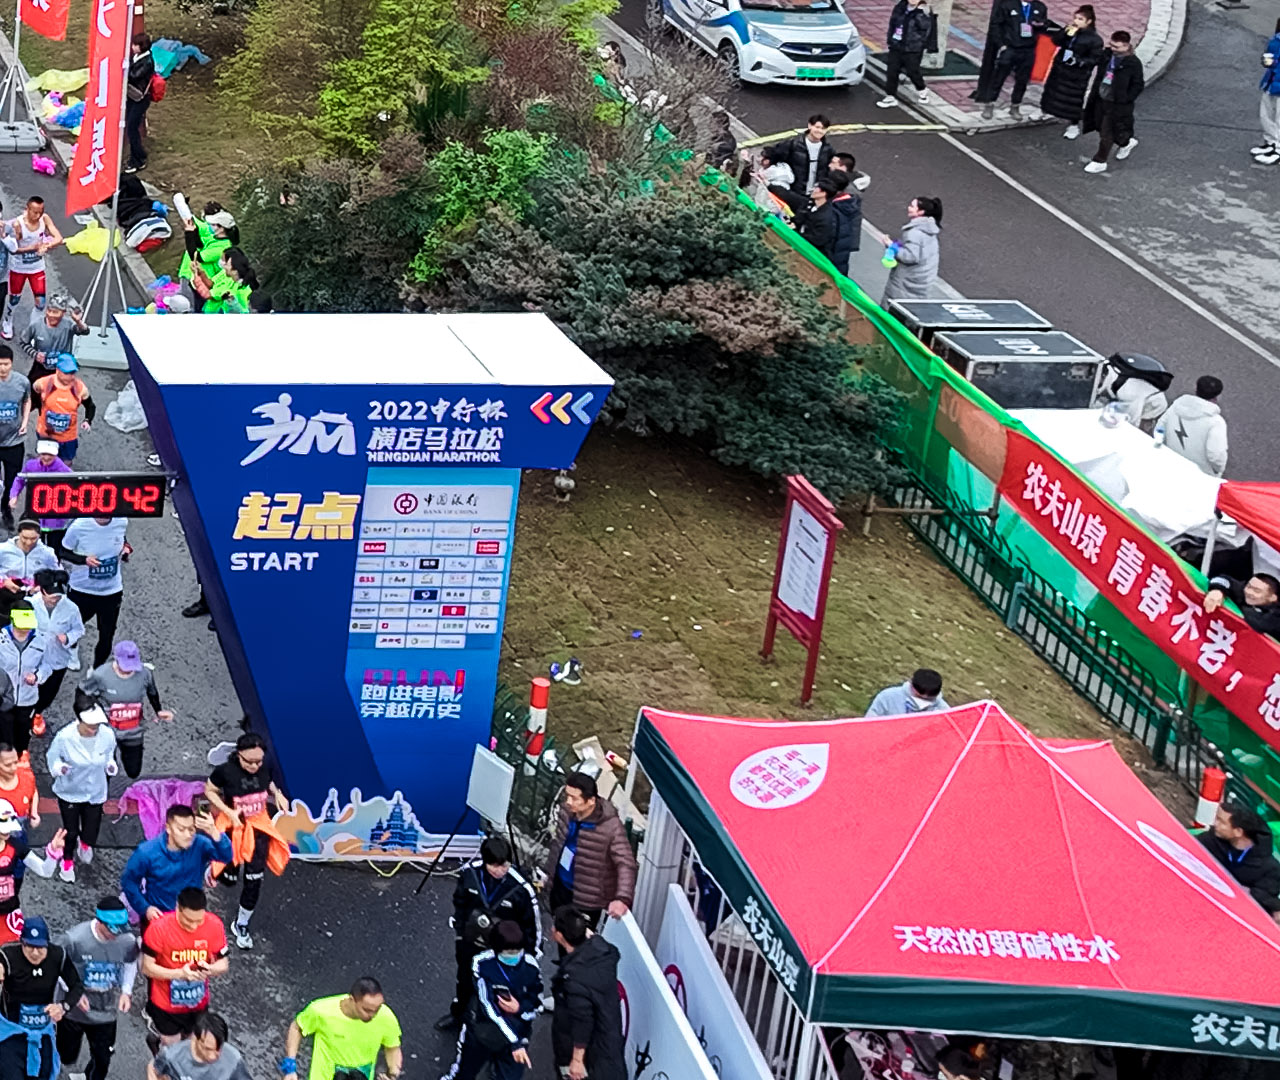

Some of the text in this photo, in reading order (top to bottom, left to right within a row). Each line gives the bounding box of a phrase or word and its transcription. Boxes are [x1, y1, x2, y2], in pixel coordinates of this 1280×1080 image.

[367, 399, 508, 424] 2022中行杯
[367, 426, 503, 452] 横店马拉松
[367, 451, 430, 463] HENGDIAN
[123, 482, 160, 513] 42
[233, 491, 361, 540] 起点
[1021, 461, 1107, 564] 农夫山泉
[230, 552, 319, 571] START
[361, 684, 462, 701] 跑进电影
[361, 702, 461, 719] 穿越历史
[743, 896, 800, 992] 农夫山泉
[893, 925, 1121, 965] 天然的弱碱性水
